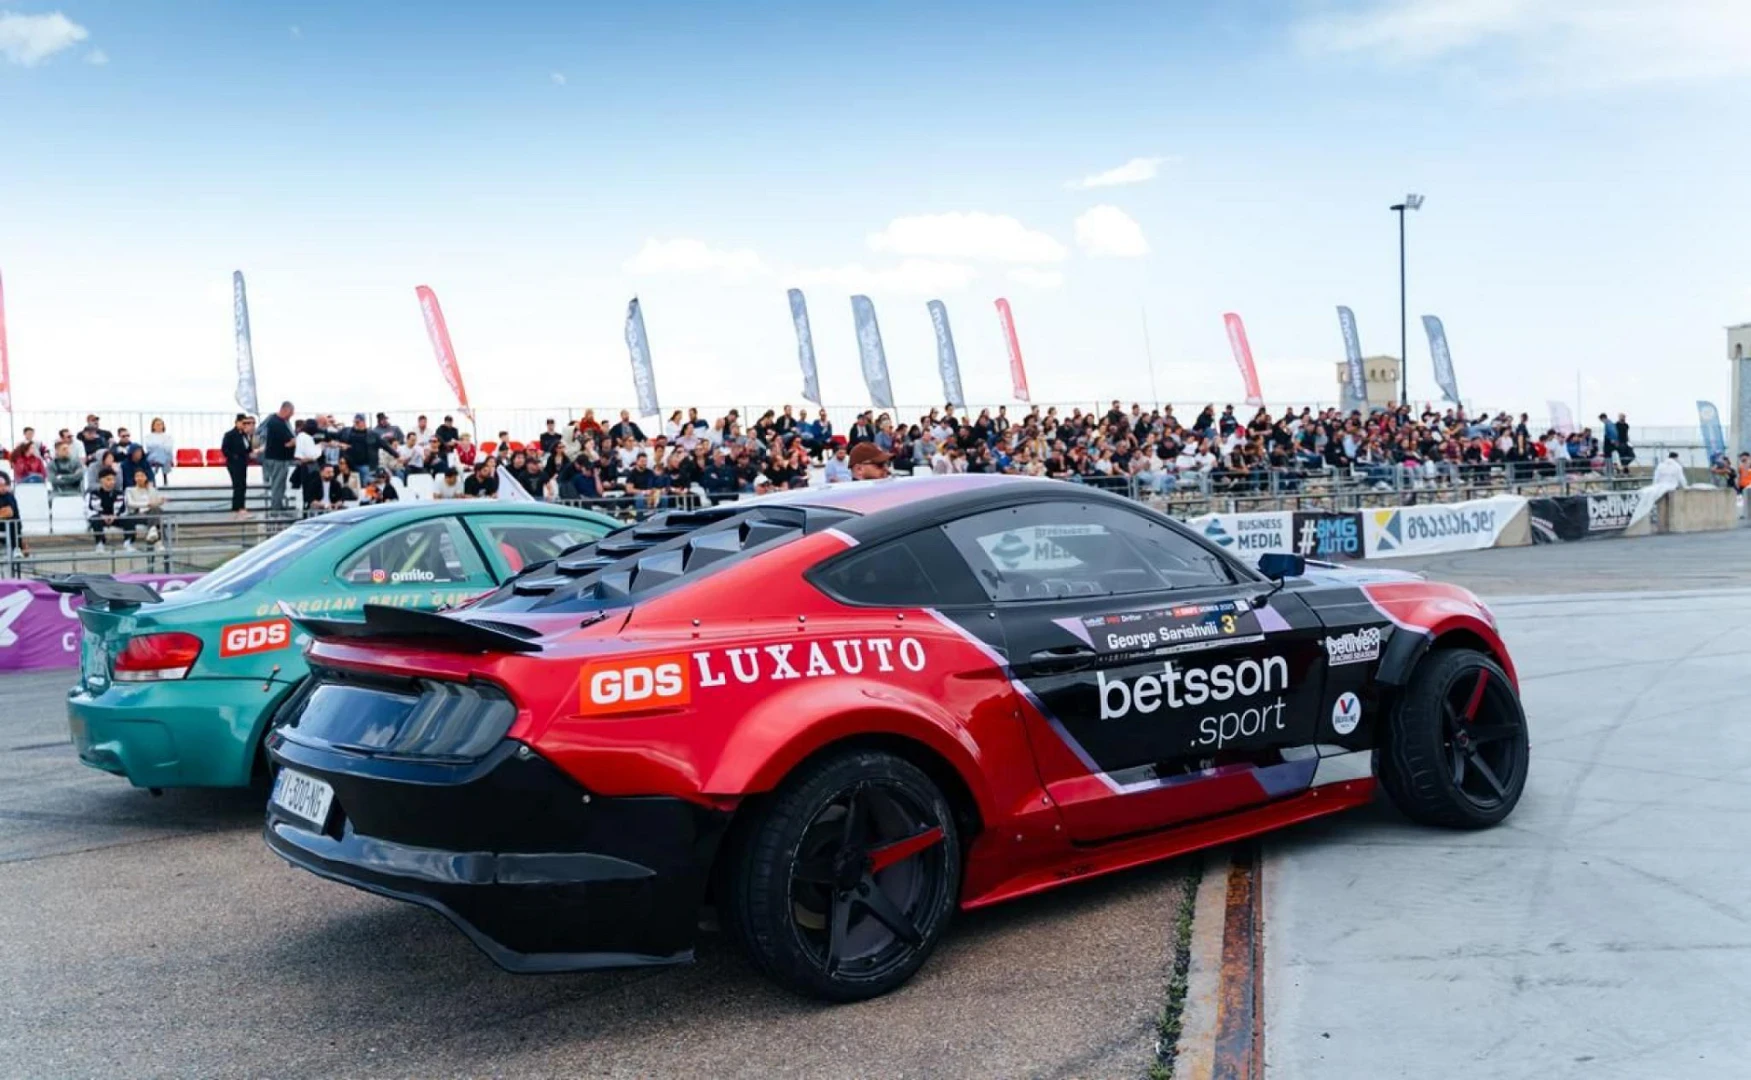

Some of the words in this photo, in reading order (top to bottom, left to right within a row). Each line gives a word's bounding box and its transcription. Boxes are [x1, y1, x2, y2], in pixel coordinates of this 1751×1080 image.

[1237, 518, 1283, 531] BUSINESS
[1237, 532, 1283, 550] MEDIA
[1317, 536, 1358, 555] AUTO
[369, 593, 422, 608] DRIFT
[226, 623, 287, 651] GDS
[1107, 632, 1157, 649] George
[1159, 620, 1219, 641] Sarishvili
[590, 662, 683, 705] GDS
[693, 637, 927, 687] LUXAUTO
[1097, 655, 1289, 720] betsson
[1190, 696, 1287, 749] .sport
